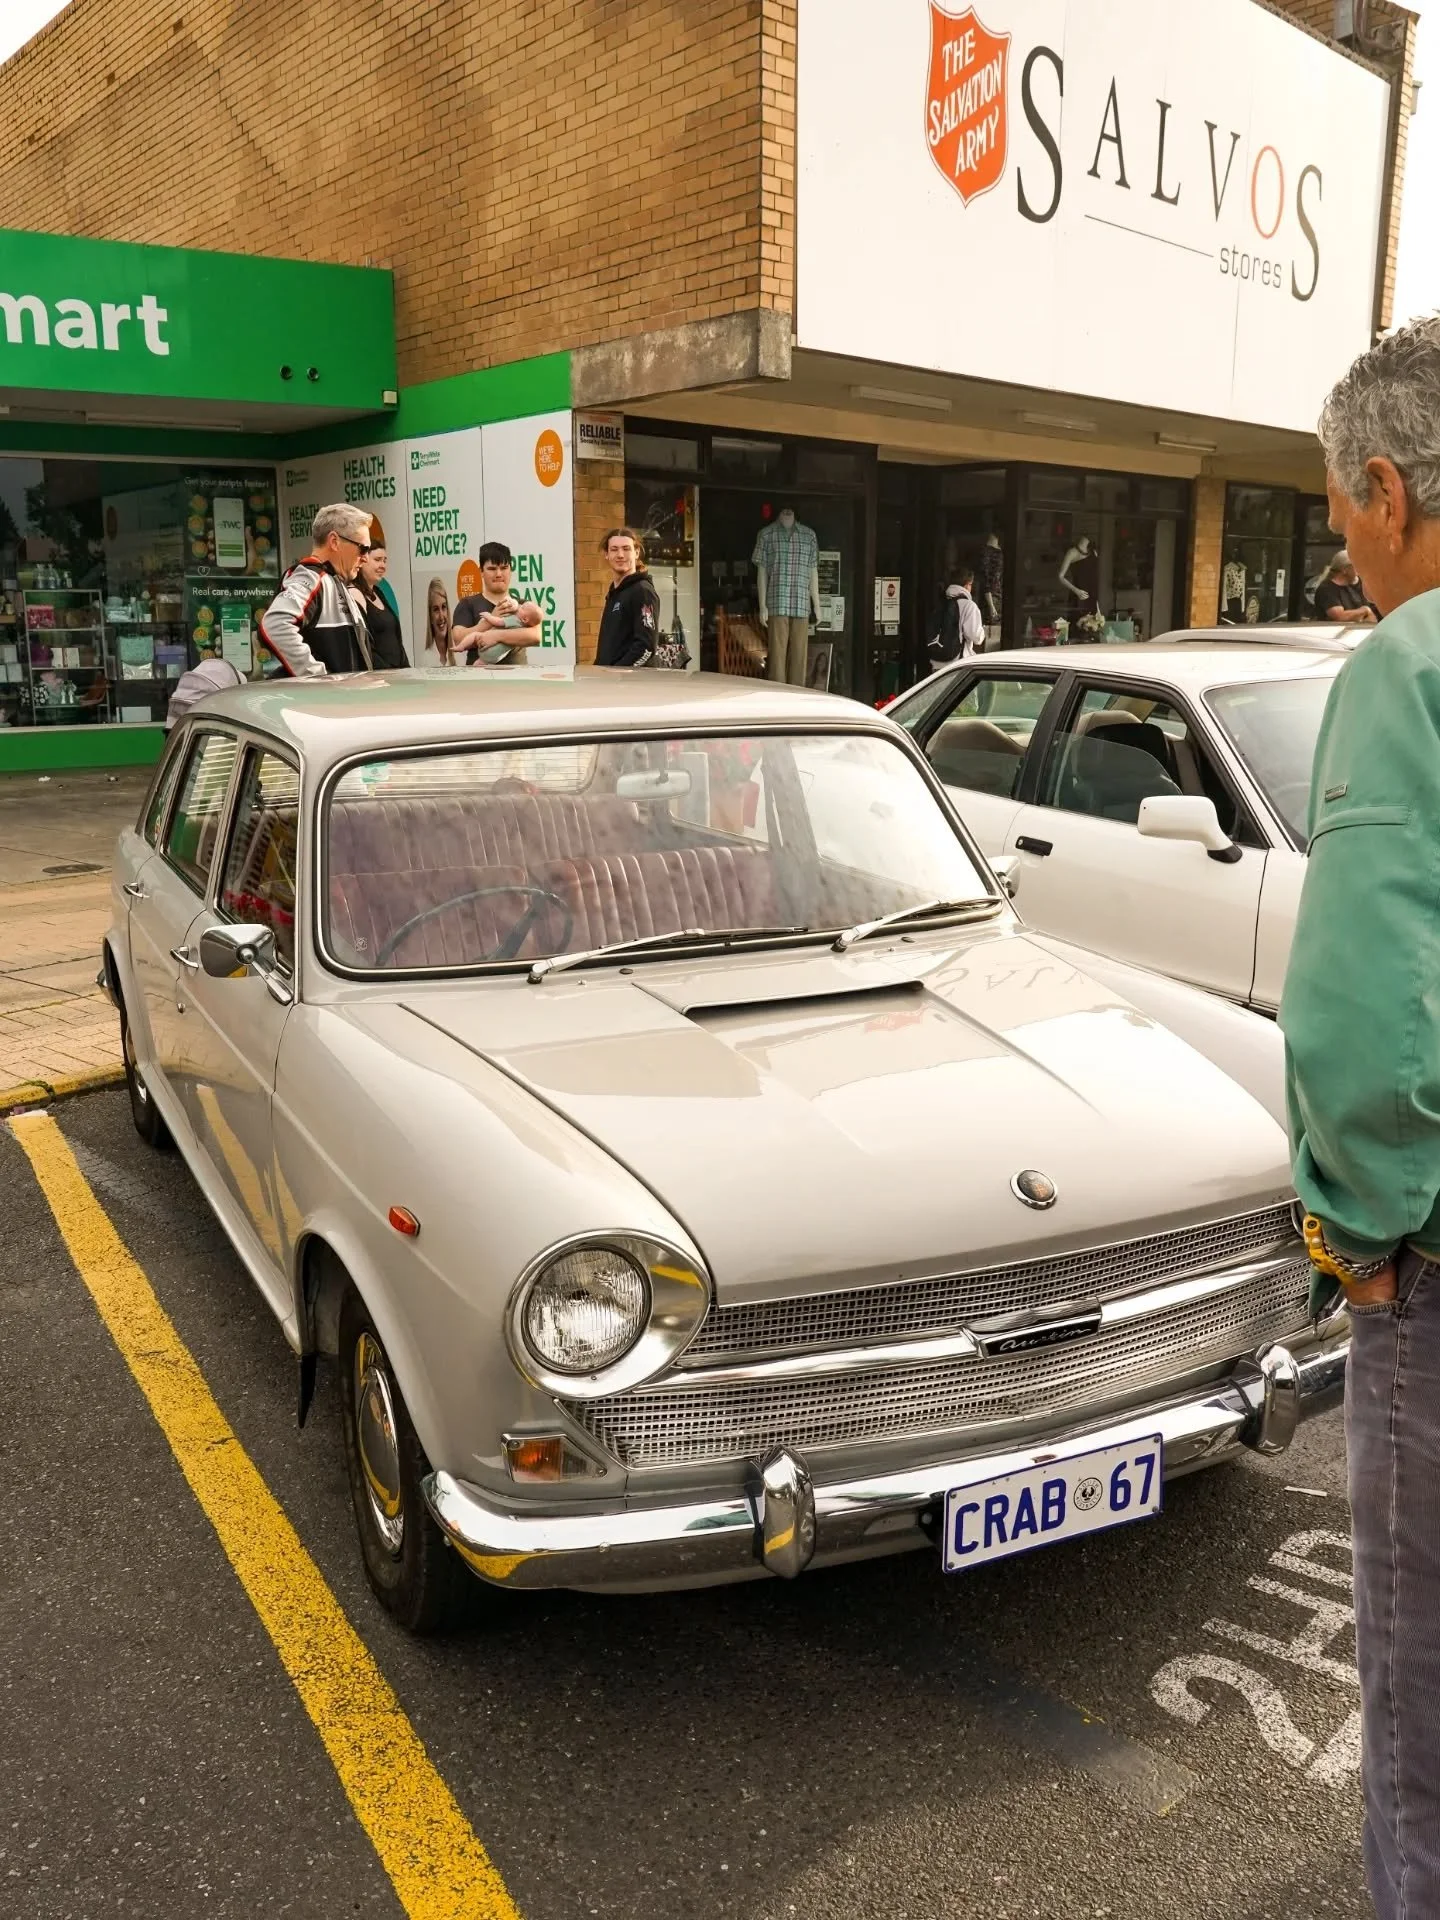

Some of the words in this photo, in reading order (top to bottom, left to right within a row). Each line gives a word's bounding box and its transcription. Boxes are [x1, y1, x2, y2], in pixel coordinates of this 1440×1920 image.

[942, 28, 976, 82] THE
[928, 50, 1003, 147] SALVATION
[955, 105, 1000, 178] ARMY
[1017, 45, 1322, 302] SALVOS
[1220, 245, 1282, 288] stores
[0, 292, 169, 356] mart
[579, 423, 622, 440] RELIABLE
[343, 455, 386, 480] HEALTH
[344, 477, 396, 502] SERVICES
[413, 486, 446, 509] NEED
[222, 520, 242, 529] TWC
[290, 521, 313, 539] SERVI
[414, 509, 459, 533] EXPERT
[415, 533, 467, 557] ADVICE?
[511, 554, 543, 582] PEN
[192, 587, 210, 596] Real
[212, 587, 232, 598] care,
[233, 587, 275, 599] anywhere
[541, 620, 567, 648] EK
[954, 1478, 1067, 1555] CRAB
[1109, 1452, 1156, 1512] 67
